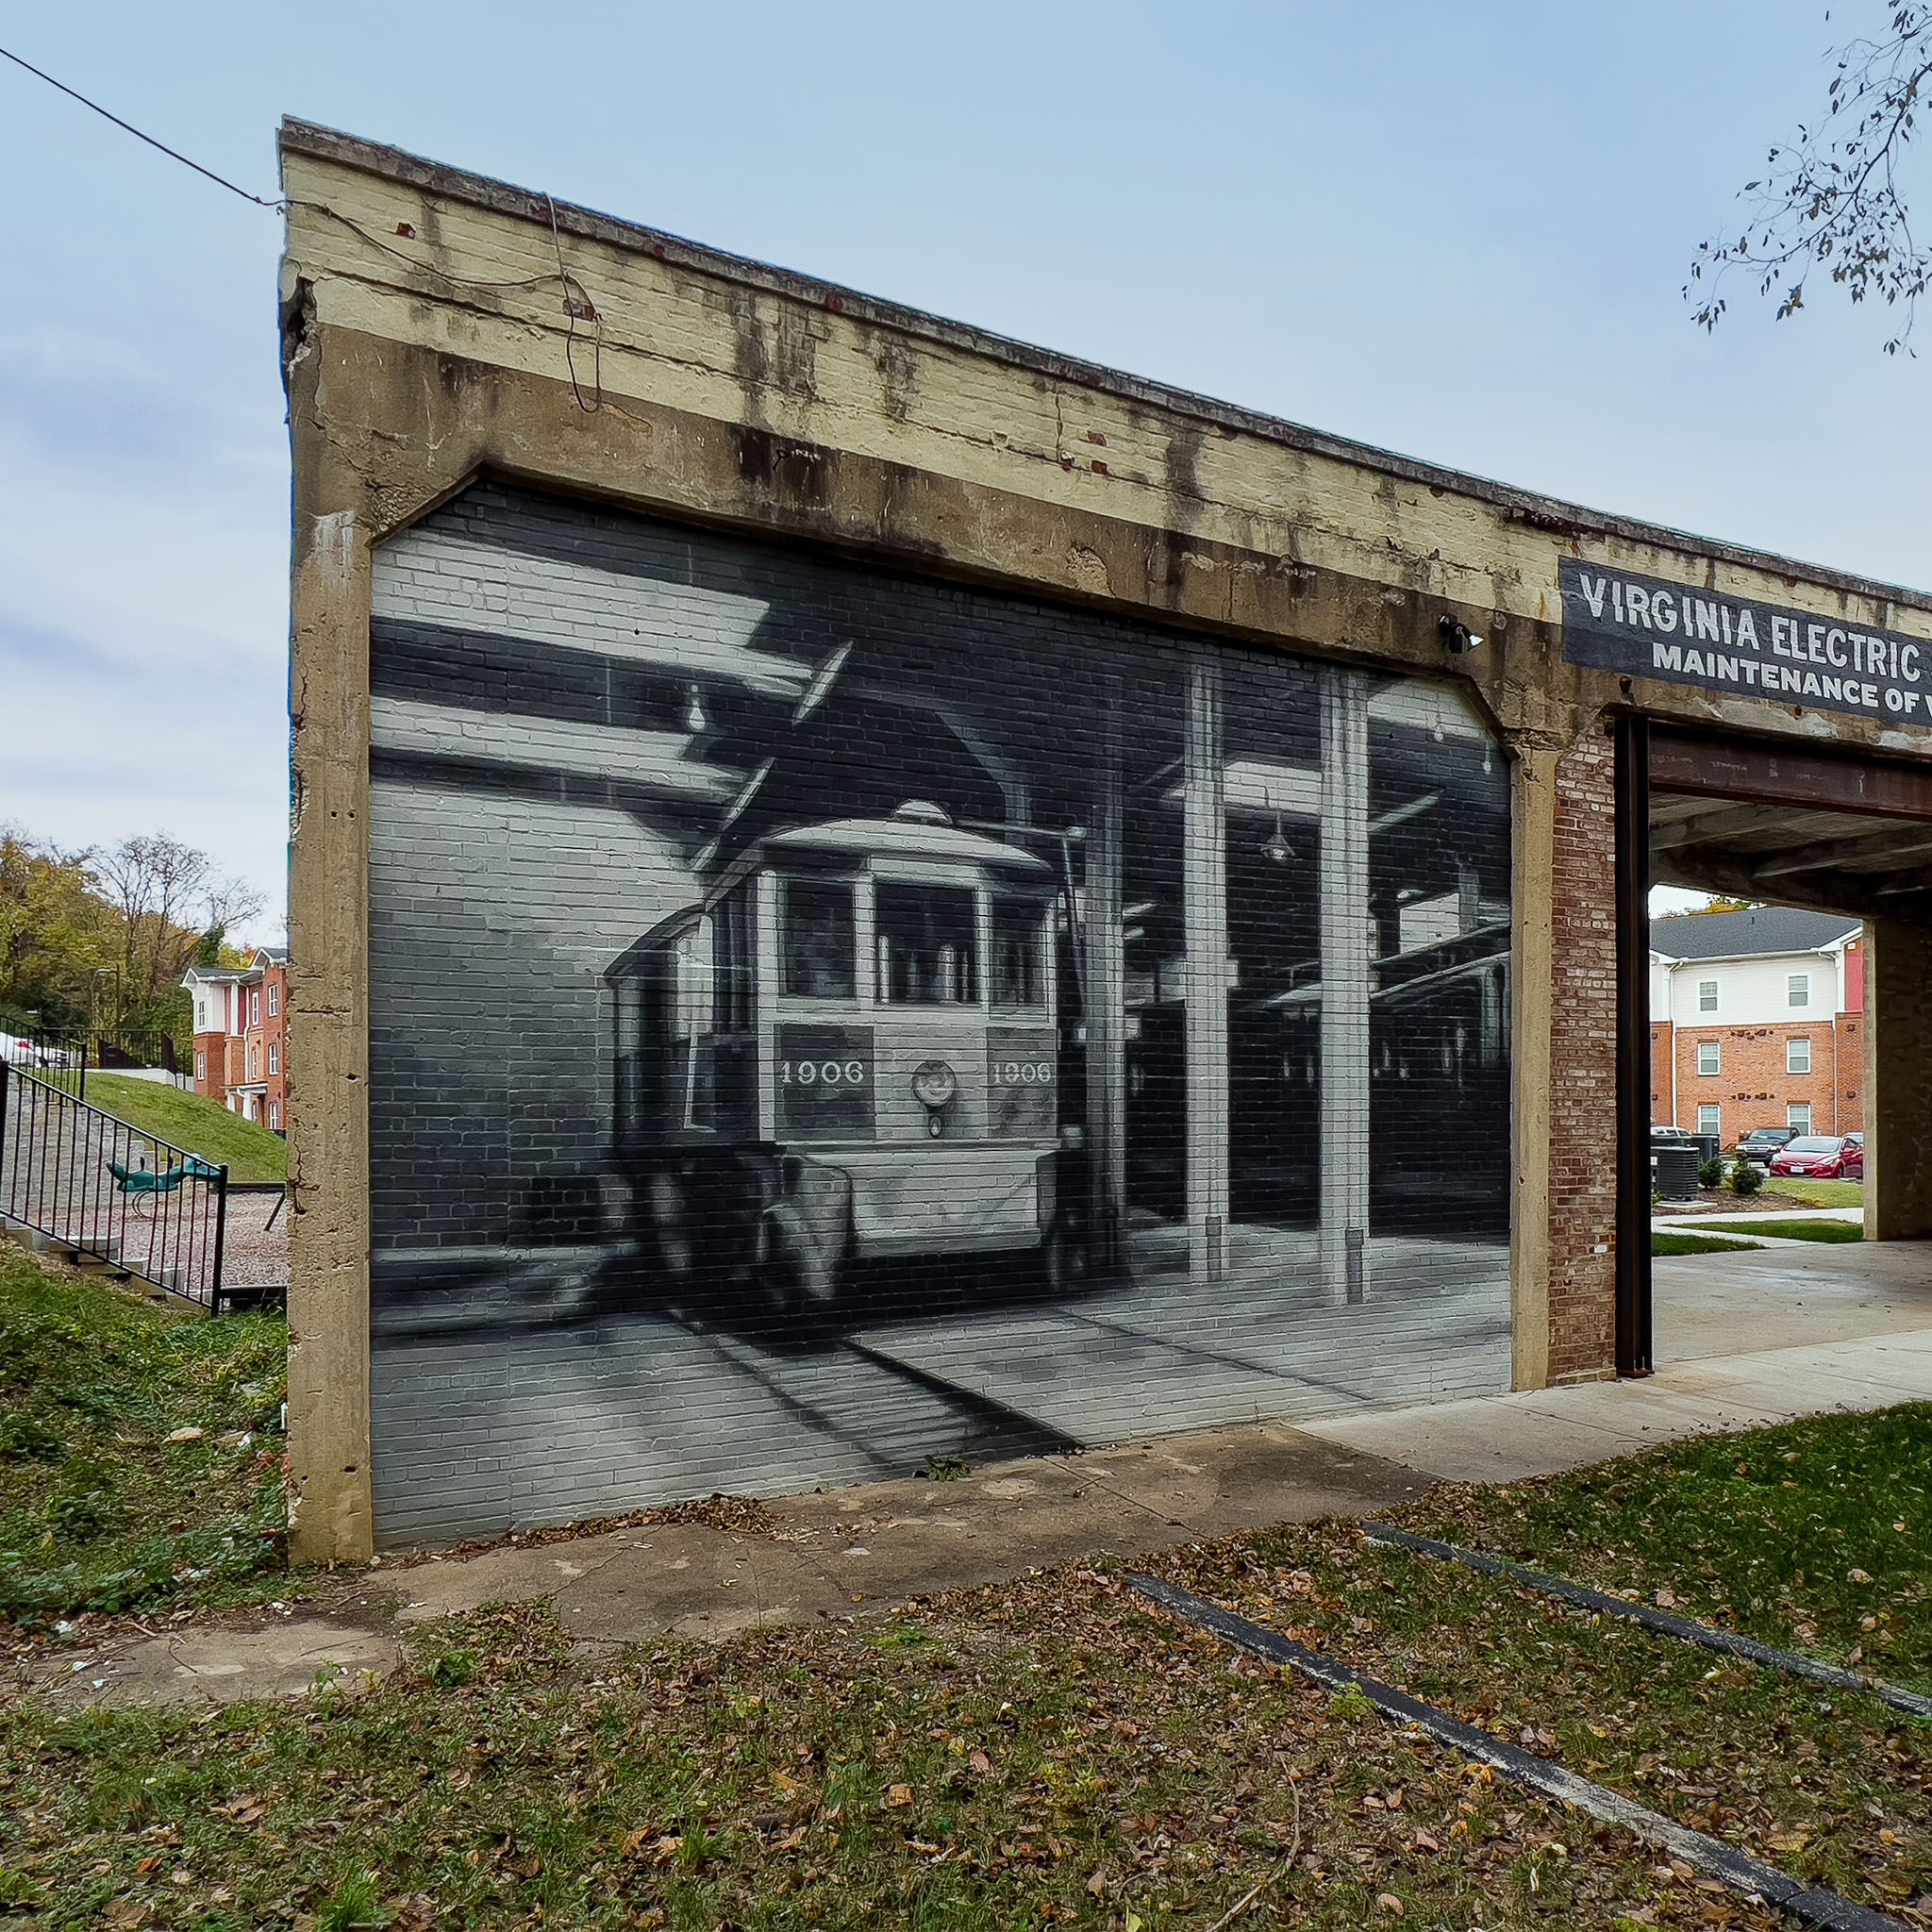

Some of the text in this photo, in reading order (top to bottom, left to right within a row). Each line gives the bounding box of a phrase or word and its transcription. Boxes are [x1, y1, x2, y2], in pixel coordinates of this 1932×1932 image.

[1579, 573, 1921, 682] VIRGINIA ELECTRIC
[1652, 642, 1879, 708] MAINTENANCE
[1885, 688, 1920, 713] OF
[780, 1061, 865, 1084] 1906
[993, 1062, 1053, 1084] 1906
